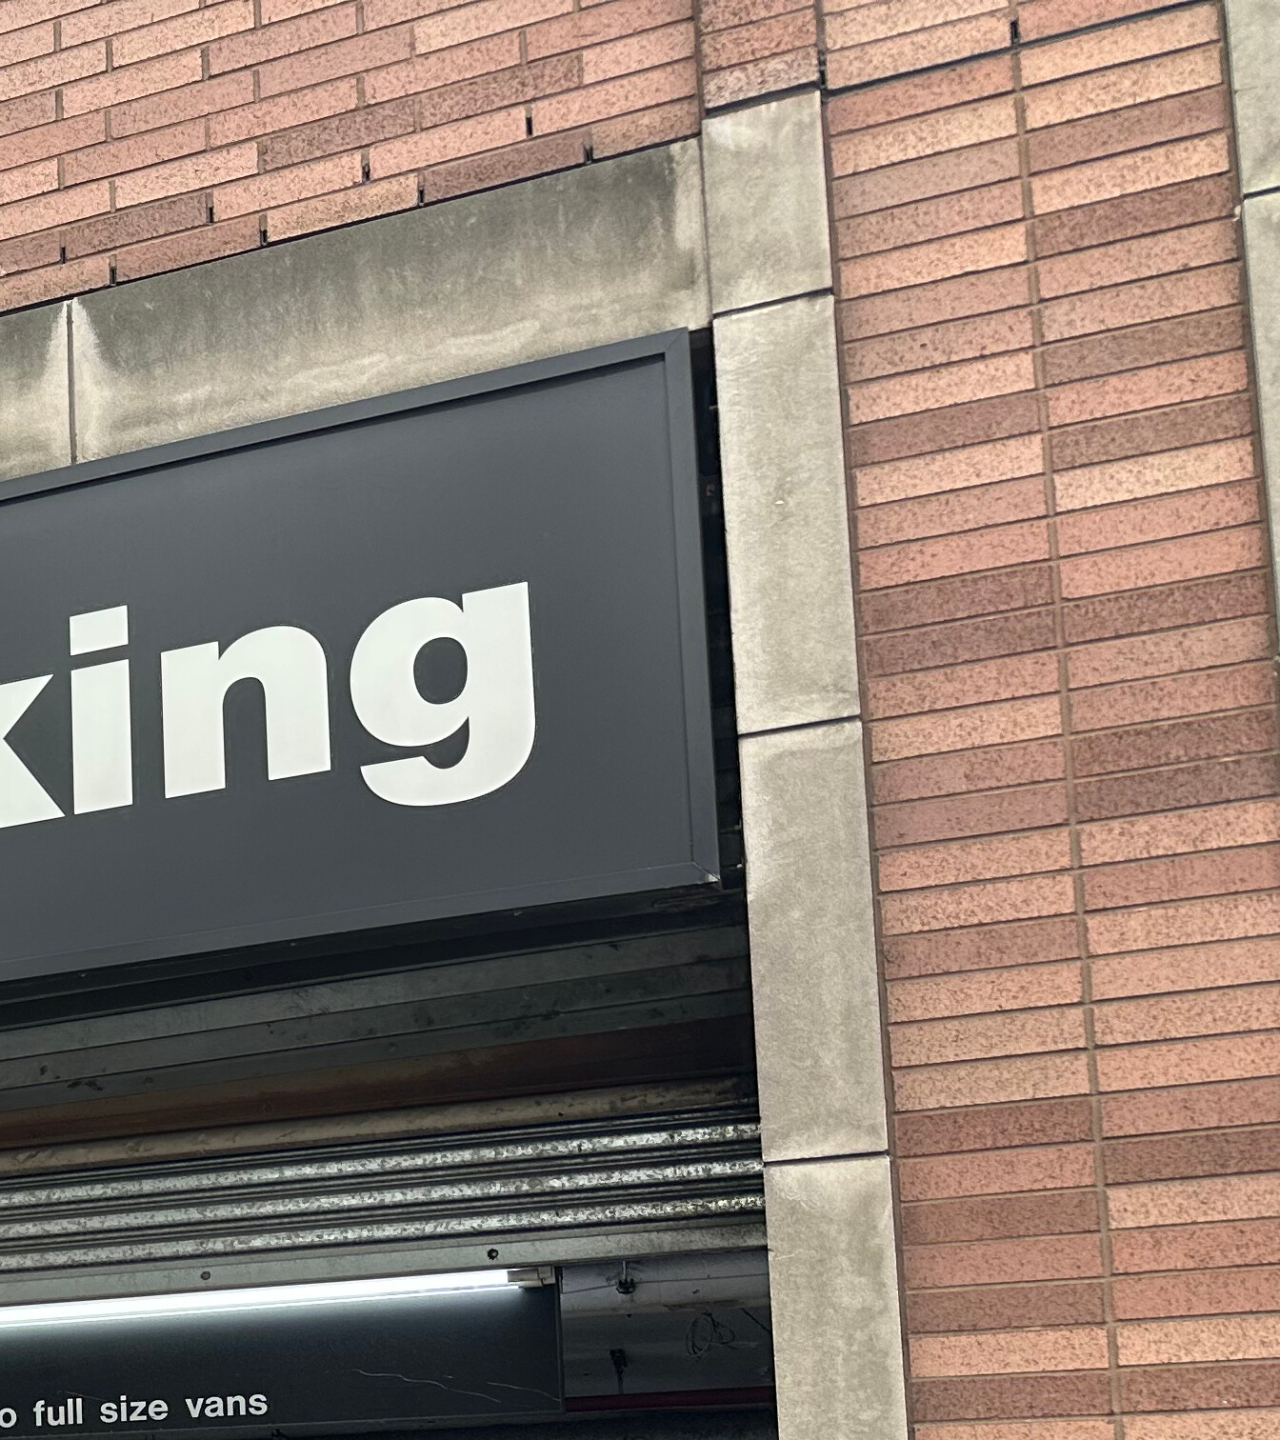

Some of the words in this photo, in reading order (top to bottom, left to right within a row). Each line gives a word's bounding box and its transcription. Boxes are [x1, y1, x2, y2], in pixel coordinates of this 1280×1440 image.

[33, 1398, 83, 1427] full
[100, 1395, 169, 1424] size
[185, 1393, 269, 1418] vans
